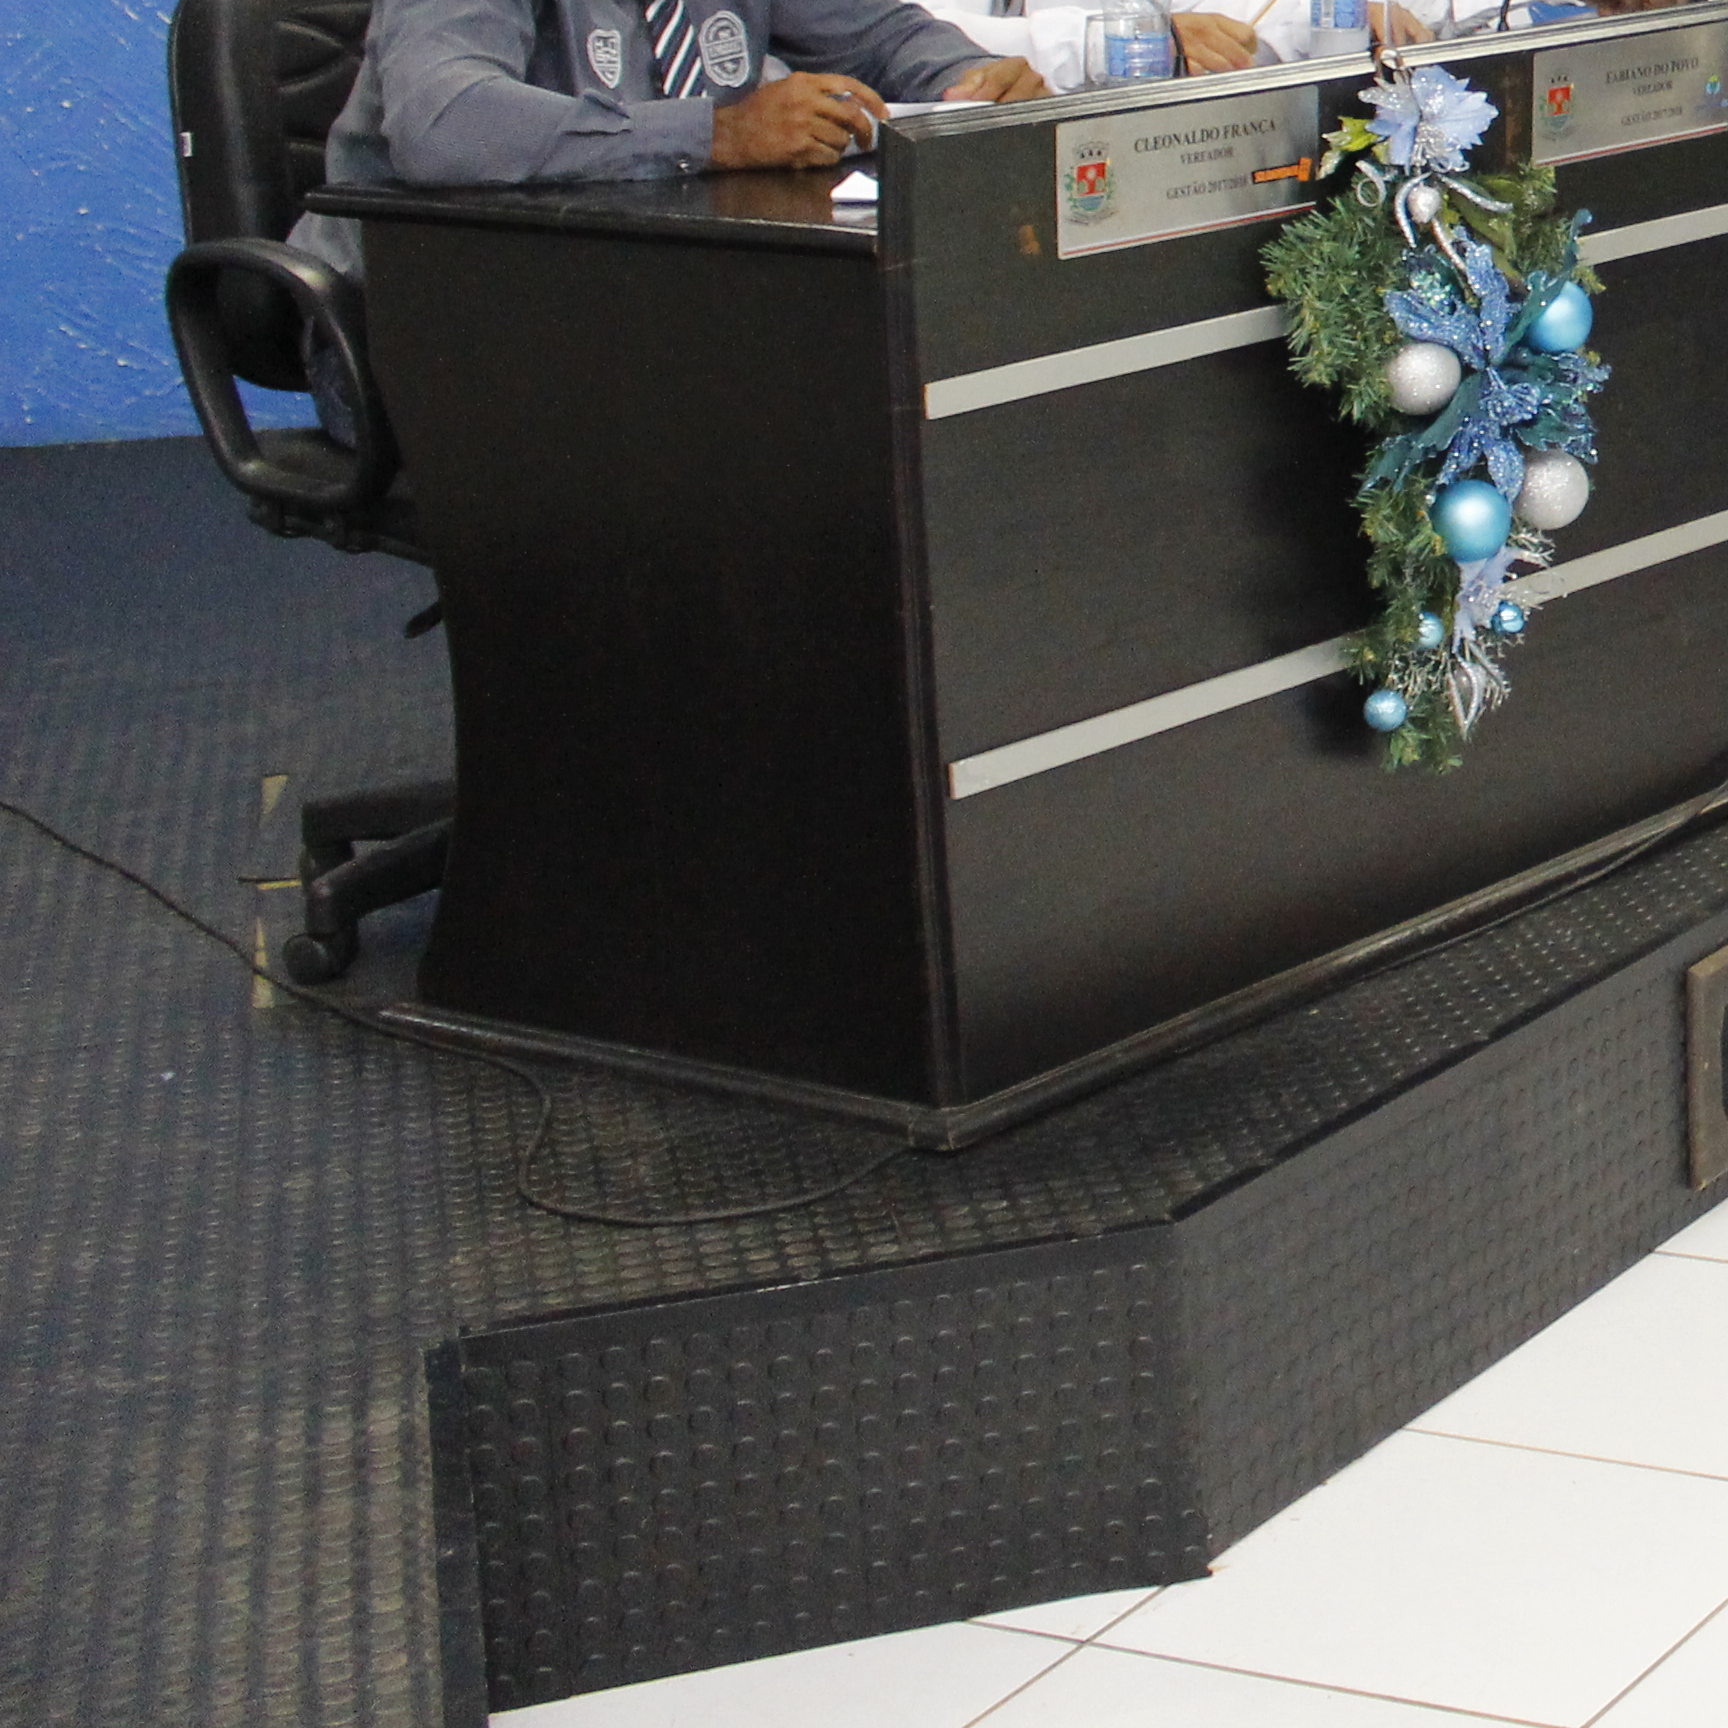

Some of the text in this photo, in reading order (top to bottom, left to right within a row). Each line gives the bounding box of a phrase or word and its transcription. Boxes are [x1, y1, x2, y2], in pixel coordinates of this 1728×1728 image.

[1134, 119, 1276, 153] CLEONALDO FRANÇA
[1180, 146, 1234, 165] VEREADOR
[1166, 179, 1206, 200] GESTÃO
